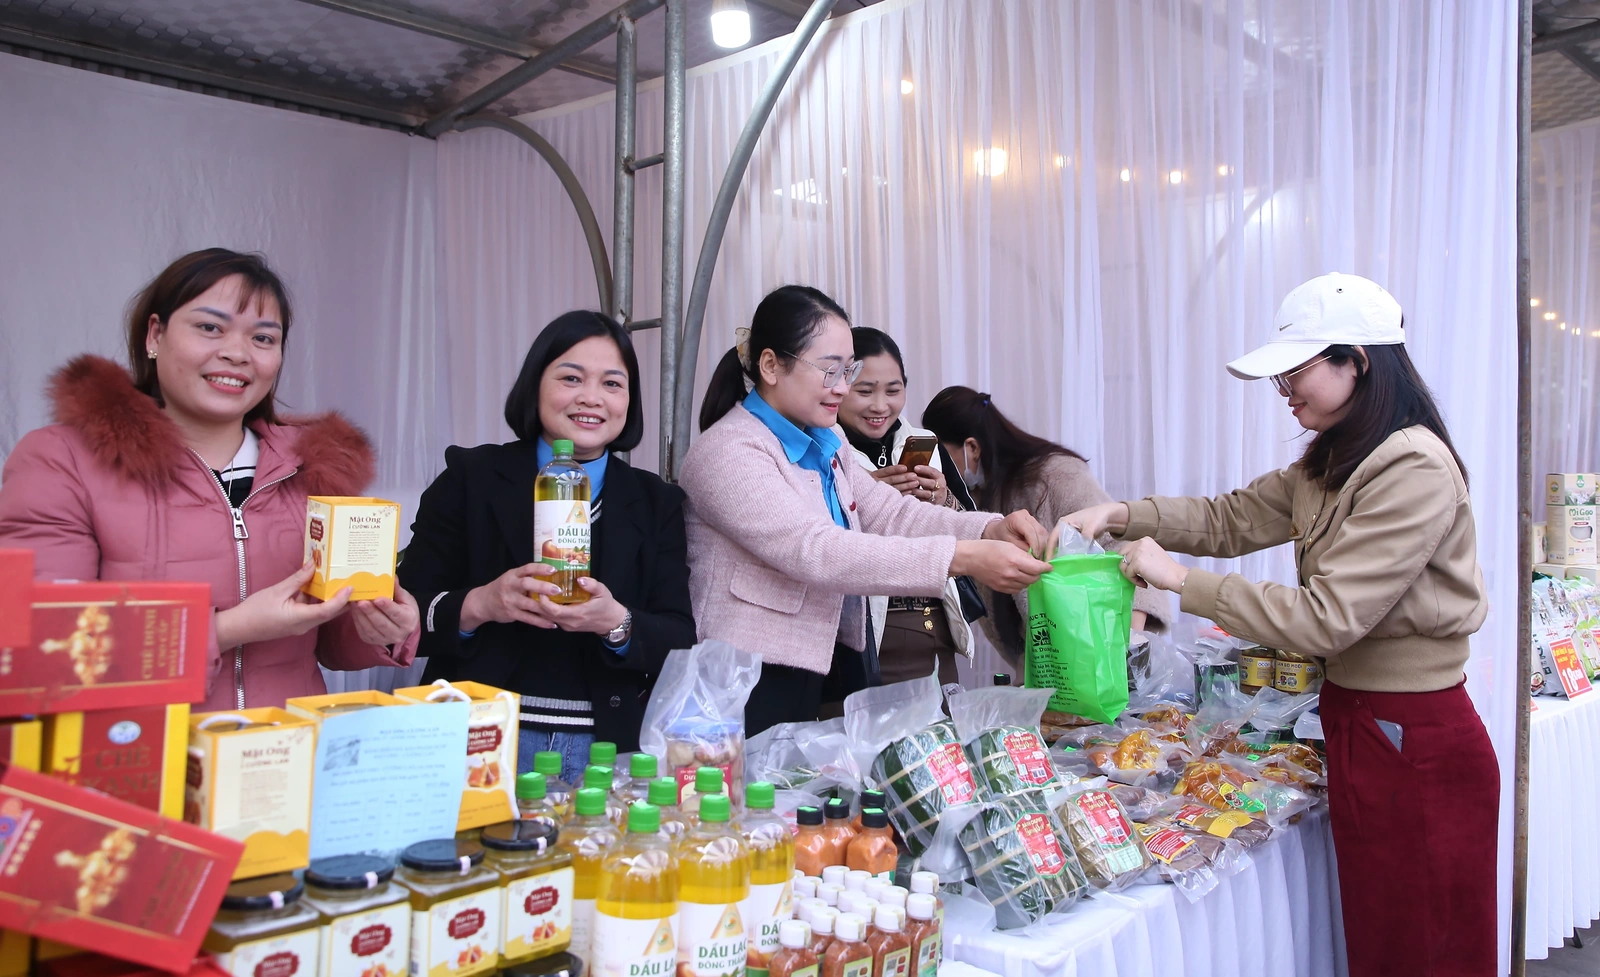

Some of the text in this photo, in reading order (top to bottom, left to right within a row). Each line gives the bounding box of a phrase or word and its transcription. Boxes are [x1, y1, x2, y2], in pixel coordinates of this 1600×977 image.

[349, 515, 382, 525] Mật Ong
[94, 744, 151, 771] CHÈ
